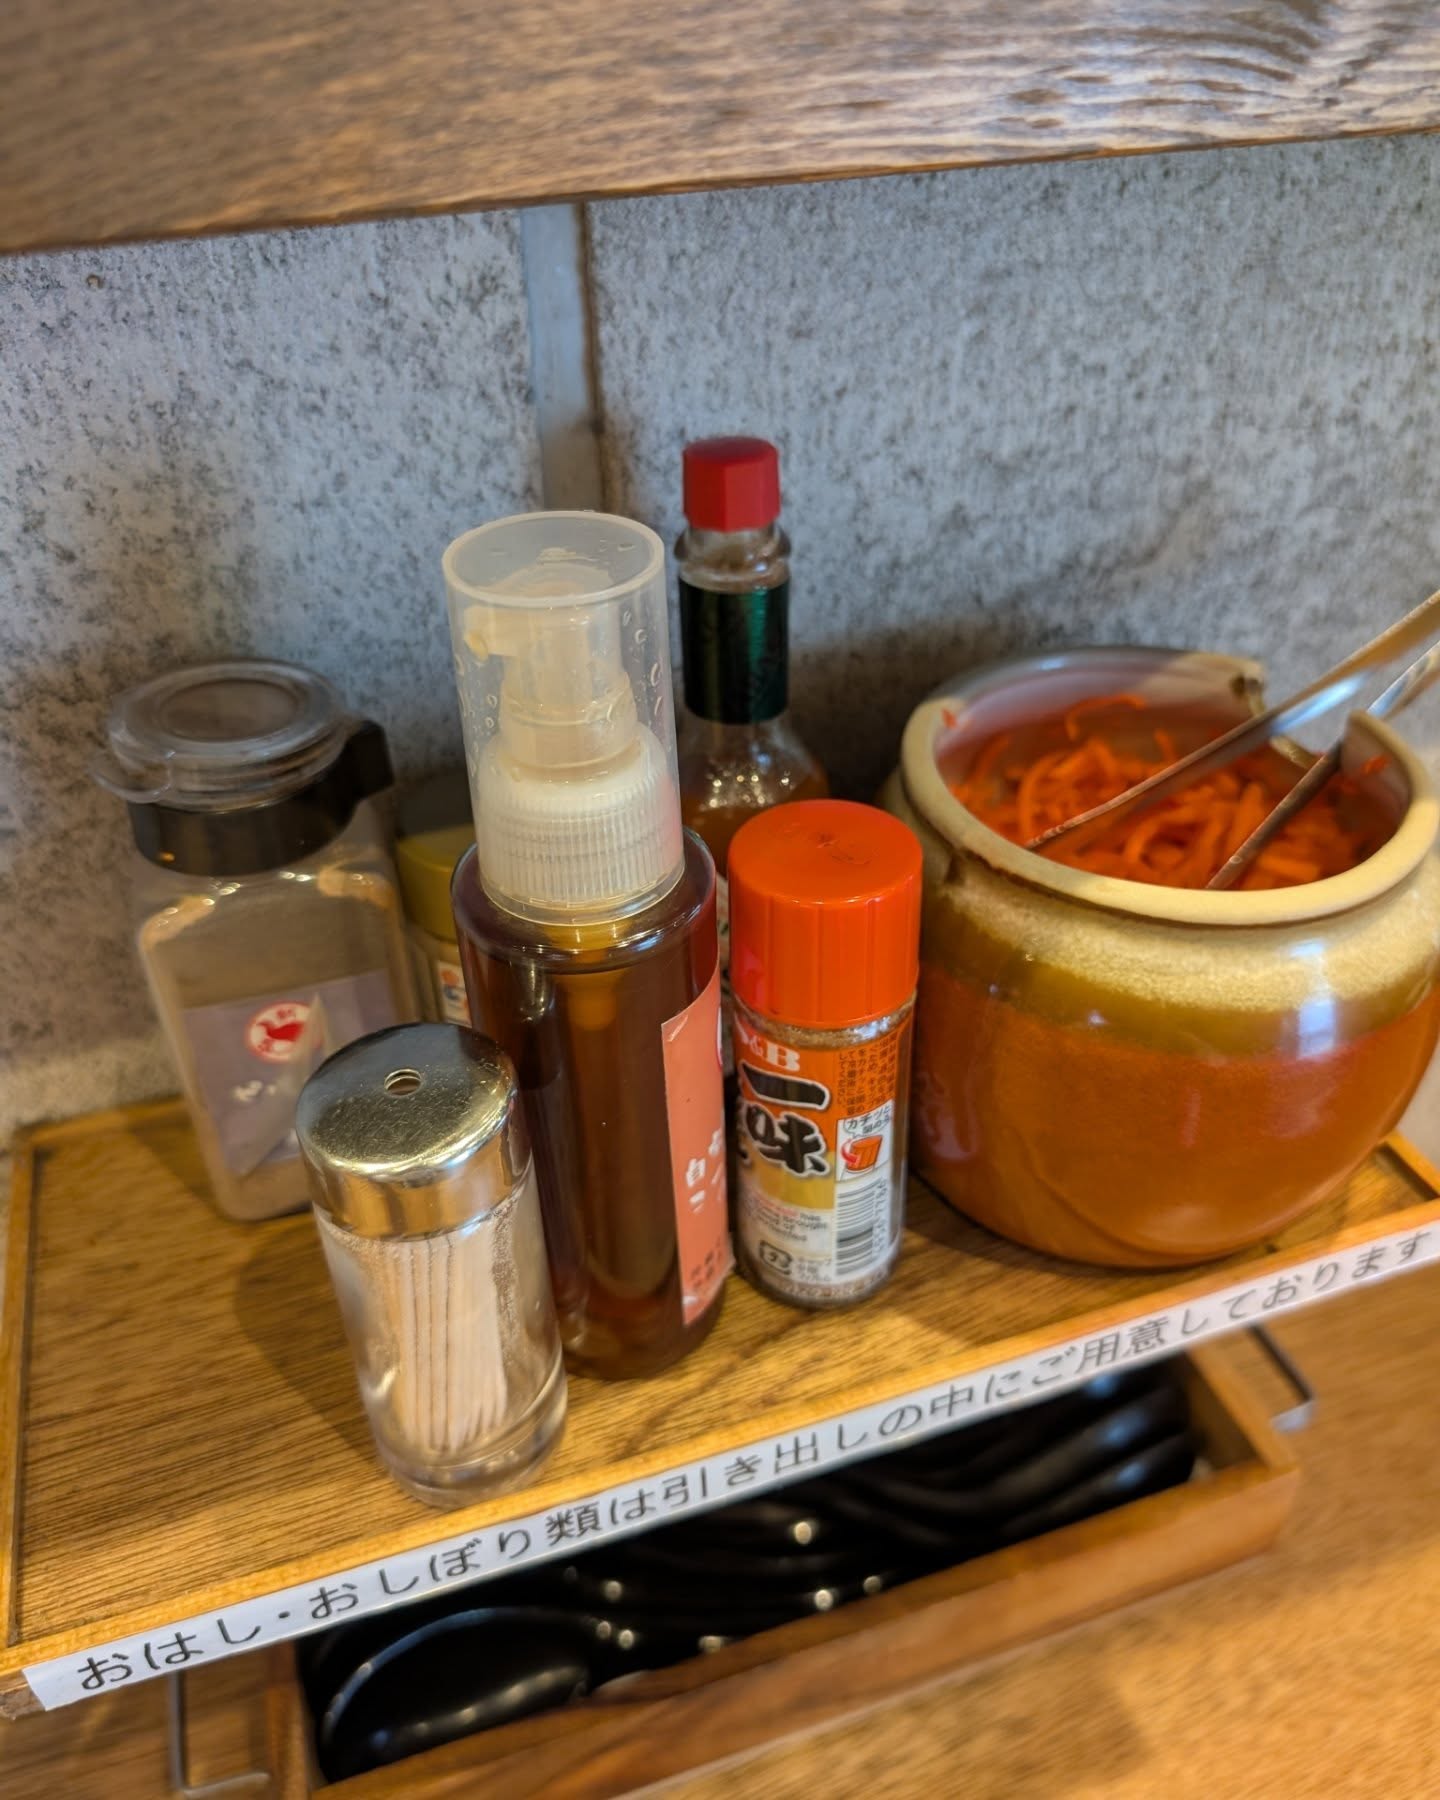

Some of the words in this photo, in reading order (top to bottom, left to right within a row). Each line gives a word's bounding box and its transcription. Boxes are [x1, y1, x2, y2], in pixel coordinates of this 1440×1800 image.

[741, 1061, 830, 1176] 一味
[77, 1231, 1432, 1690] おはし・おしぼり類は引き出しの中にご用意しております
